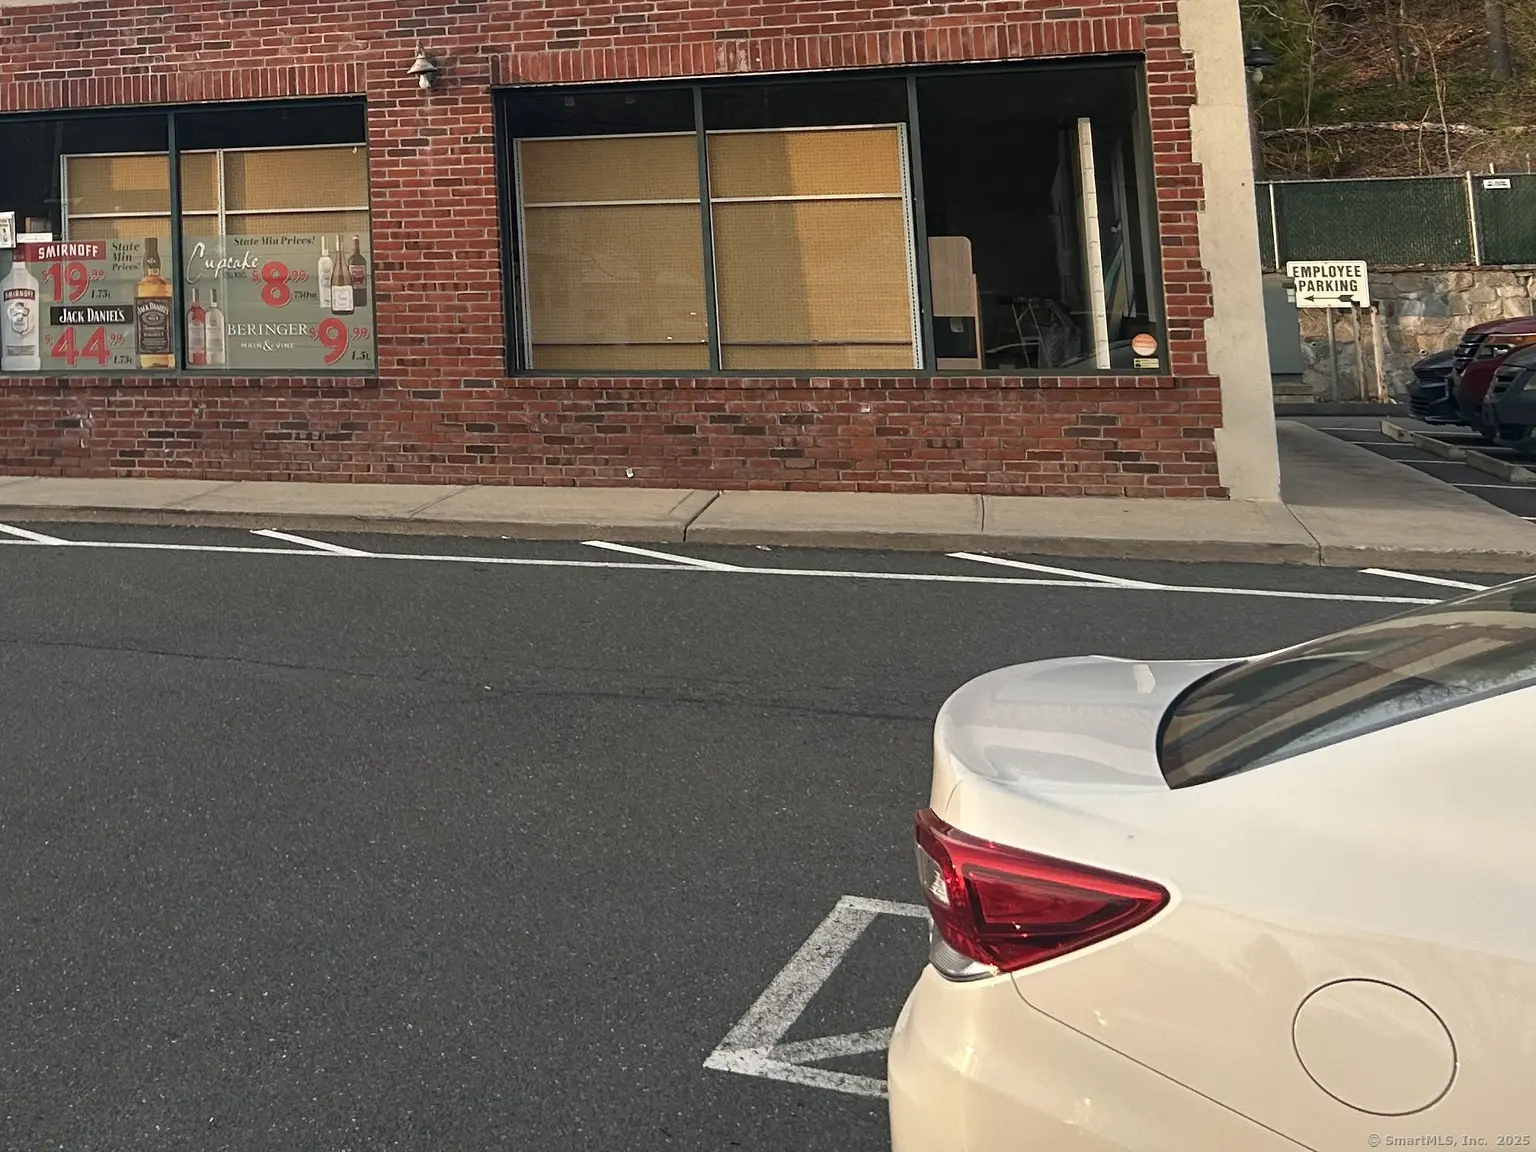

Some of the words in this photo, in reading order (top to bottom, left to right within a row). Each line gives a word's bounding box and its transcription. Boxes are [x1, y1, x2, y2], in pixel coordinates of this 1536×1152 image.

[112, 242, 140, 252] State
[234, 237, 259, 246] State
[262, 236, 279, 246] Min
[281, 235, 316, 245] Prices!
[38, 244, 99, 260] SMIRNOFF
[113, 252, 133, 262] Min
[112, 262, 141, 272] Prices!
[186, 241, 260, 285] Cupcake
[1292, 265, 1362, 278] EMPLOYEE
[1298, 279, 1358, 292] PARKING
[4, 290, 35, 300] SMIRNOFF
[59, 308, 85, 323] JACK
[87, 307, 126, 323] DANIEL'S
[227, 323, 308, 336] BERINGER
